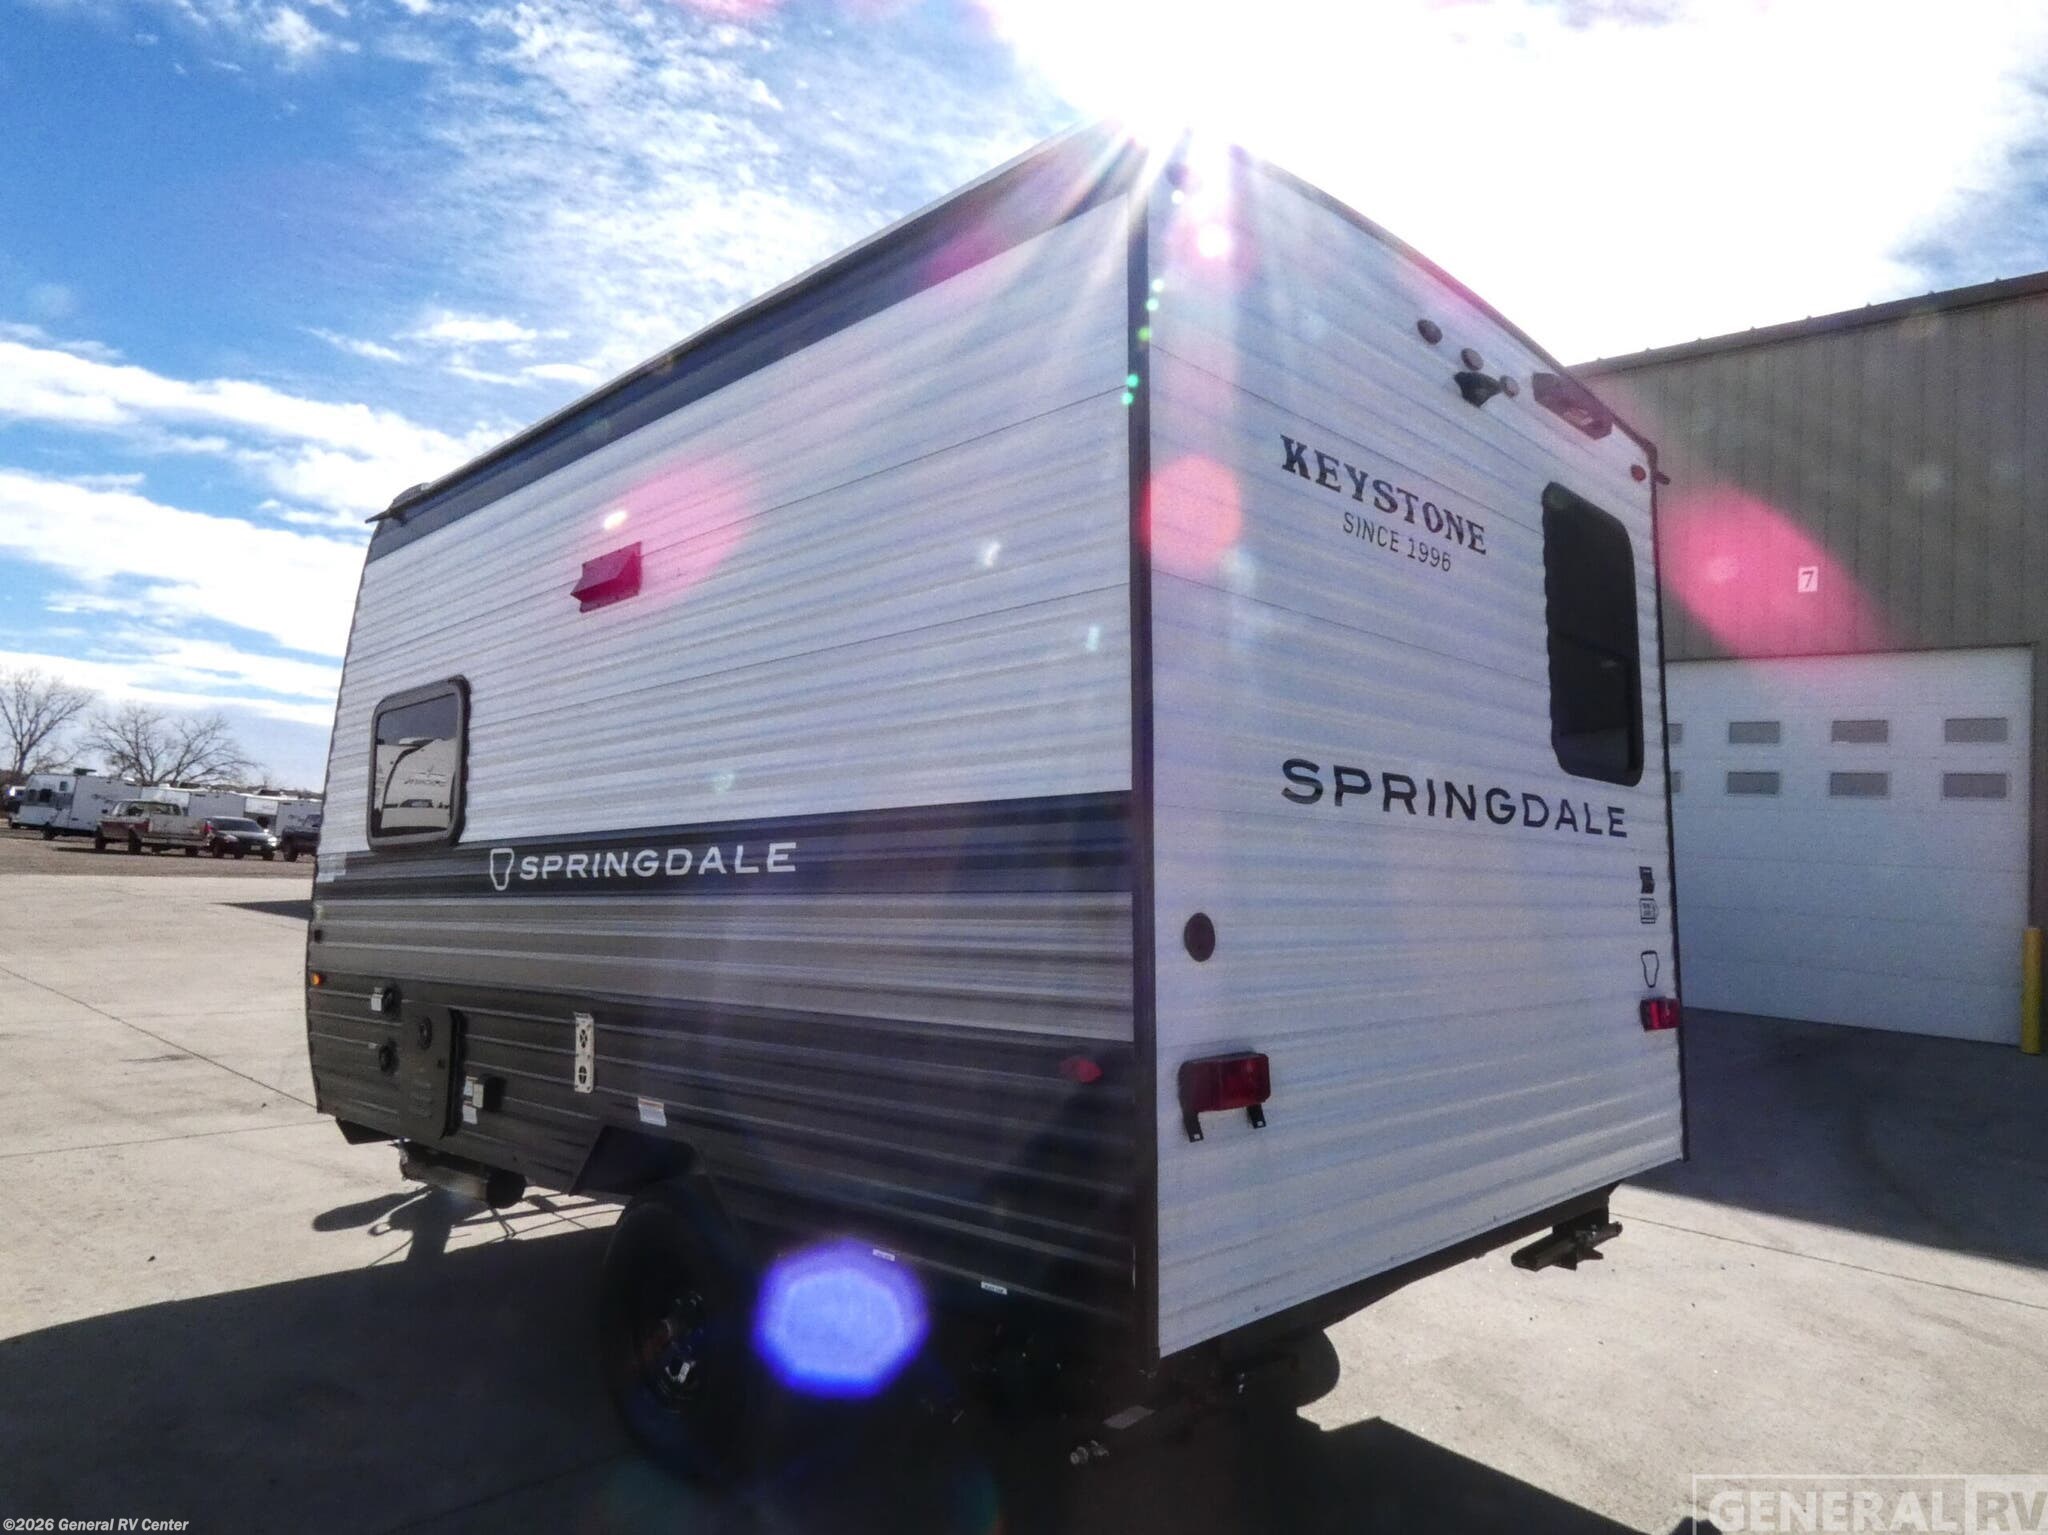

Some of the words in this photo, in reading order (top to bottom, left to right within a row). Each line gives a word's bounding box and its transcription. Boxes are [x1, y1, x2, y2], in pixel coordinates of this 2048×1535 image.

[1280, 434, 1486, 555] KEYSTONE
[1343, 512, 1399, 553] SINCE
[1407, 538, 1451, 572] 1996
[1802, 570, 1814, 588] 7
[1281, 758, 1628, 838] SPRINGDALE
[519, 842, 797, 880] SPRINGDALE
